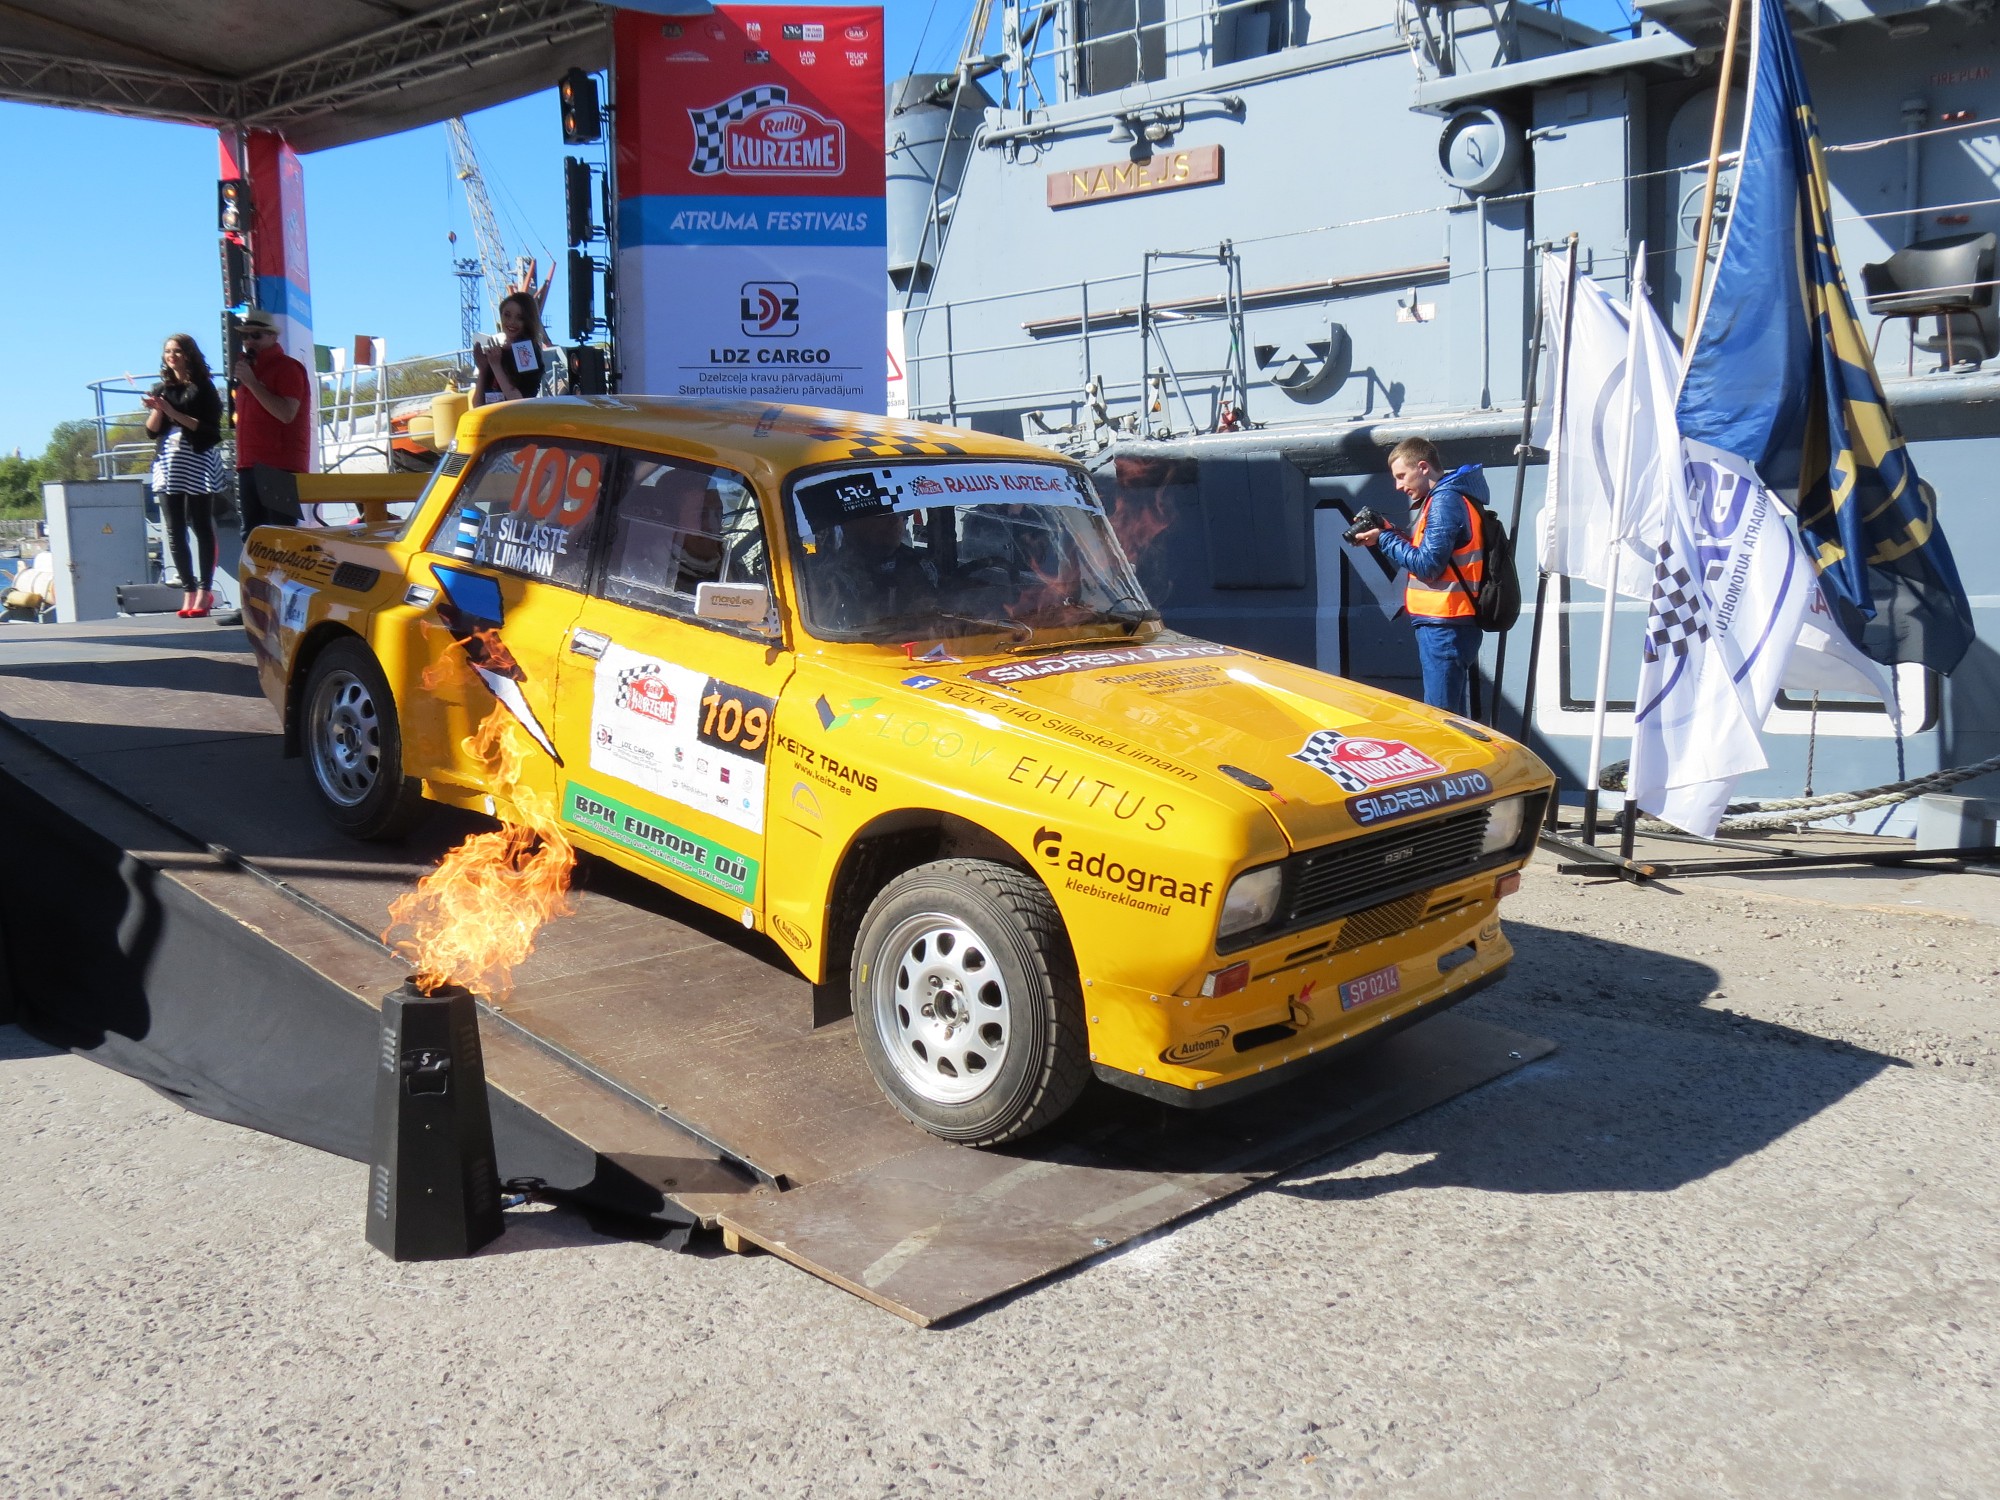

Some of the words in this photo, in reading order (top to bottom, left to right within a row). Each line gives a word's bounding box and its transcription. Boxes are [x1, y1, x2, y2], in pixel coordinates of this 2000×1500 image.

[799, 51, 816, 59] LADA
[845, 51, 868, 60] TRUCK
[849, 59, 864, 67] CUP
[763, 115, 804, 134] Rally
[732, 132, 836, 168] KURZEME
[1072, 154, 1190, 199] NAMEJS
[710, 348, 750, 364] LDZ
[757, 348, 831, 364] CARGO
[679, 384, 747, 396] Starptautiskie
[750, 384, 799, 397] pasažieru
[802, 384, 864, 397] pārvadājumi
[699, 372, 748, 384] Dzelzceļa
[751, 372, 779, 383] kravu
[782, 372, 844, 384] pārvadājumi
[513, 443, 602, 527] 109
[944, 474, 999, 494] RALLIJS
[1000, 473, 1063, 494] KURZEME
[480, 514, 494, 538] A.
[498, 517, 569, 555] SILLASTE
[475, 539, 489, 563] A.
[493, 541, 555, 577] LIIMANN
[988, 652, 1142, 682] SILDREM
[1146, 645, 1226, 660] AUTO
[701, 693, 769, 751] 109
[876, 712, 998, 768] LOOV
[936, 685, 988, 706] AZLK
[990, 702, 1042, 723] 2140
[1042, 718, 1199, 782] Sillaste/Liimann
[777, 734, 815, 765] KEITZ
[820, 754, 878, 793] TRANS
[794, 760, 852, 796] www.keitz.ee
[1340, 749, 1436, 782] KURZEME
[1007, 755, 1176, 832] EHITUS
[1355, 785, 1441, 823] SILDREM
[1442, 774, 1487, 801] AUTO
[575, 794, 617, 826] BPK
[623, 815, 708, 865] EUROPE
[714, 856, 748, 883] OÜ
[672, 856, 693, 872] Europe
[698, 868, 712, 879] BPK
[711, 873, 734, 890] Europe
[1066, 850, 1213, 908] adograaf
[1065, 876, 1171, 917] kleebisreklaamid
[1350, 980, 1367, 1004] SP
[1369, 969, 1397, 996] 0214
[420, 1052, 431, 1066] 5
[1181, 1038, 1221, 1055] Automa
